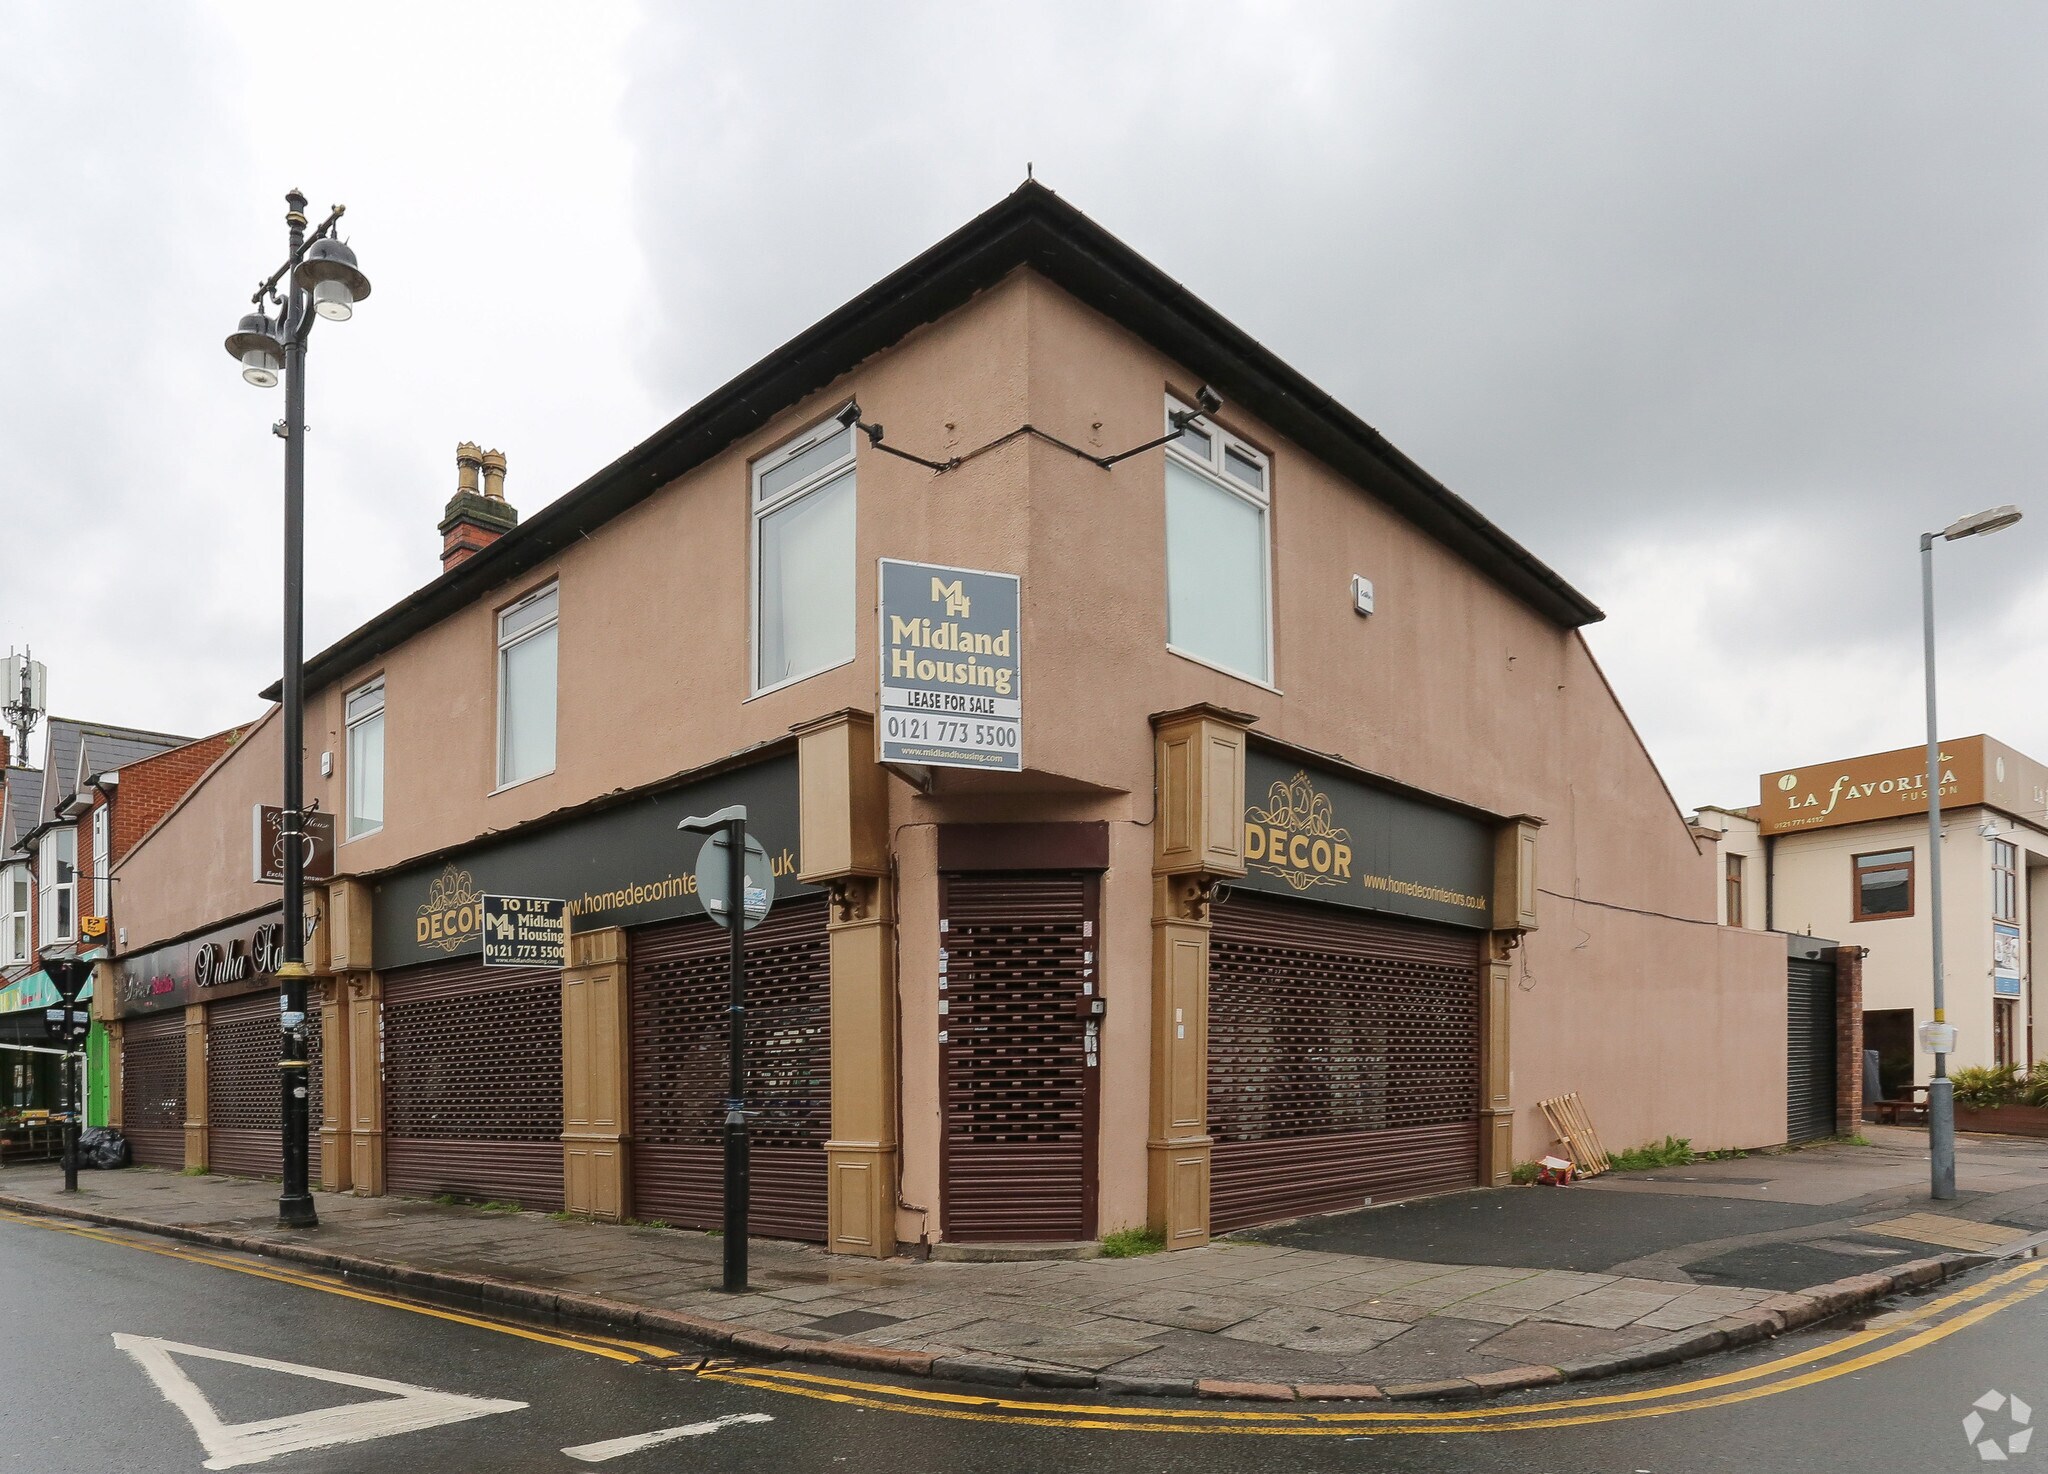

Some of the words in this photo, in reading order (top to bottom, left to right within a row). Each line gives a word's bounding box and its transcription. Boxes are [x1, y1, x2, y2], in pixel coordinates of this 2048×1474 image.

[890, 615, 1011, 657] Midland
[891, 648, 1013, 695] Housing
[908, 691, 941, 709] LEASE
[944, 695, 965, 711] FOR
[969, 697, 995, 714] SALE
[888, 716, 928, 740] 0121
[938, 721, 968, 743] 773
[975, 724, 1016, 748] 5500
[901, 747, 1003, 763] www.midlandhousing.com
[1788, 793, 1819, 810] LA
[1820, 769, 1958, 816] fAVORIA
[1901, 785, 1958, 802] FUSON
[1245, 822, 1352, 878] DECOR
[501, 899, 521, 911] TO
[527, 900, 550, 912] LET
[1363, 874, 1486, 910] www.homedecorinteriors.co.uk
[517, 914, 563, 929] Midland
[519, 928, 564, 944] Housing
[194, 940, 245, 987] Dulha
[486, 944, 512, 957] 0121
[517, 945, 537, 958] 773
[541, 946, 564, 958] 5500
